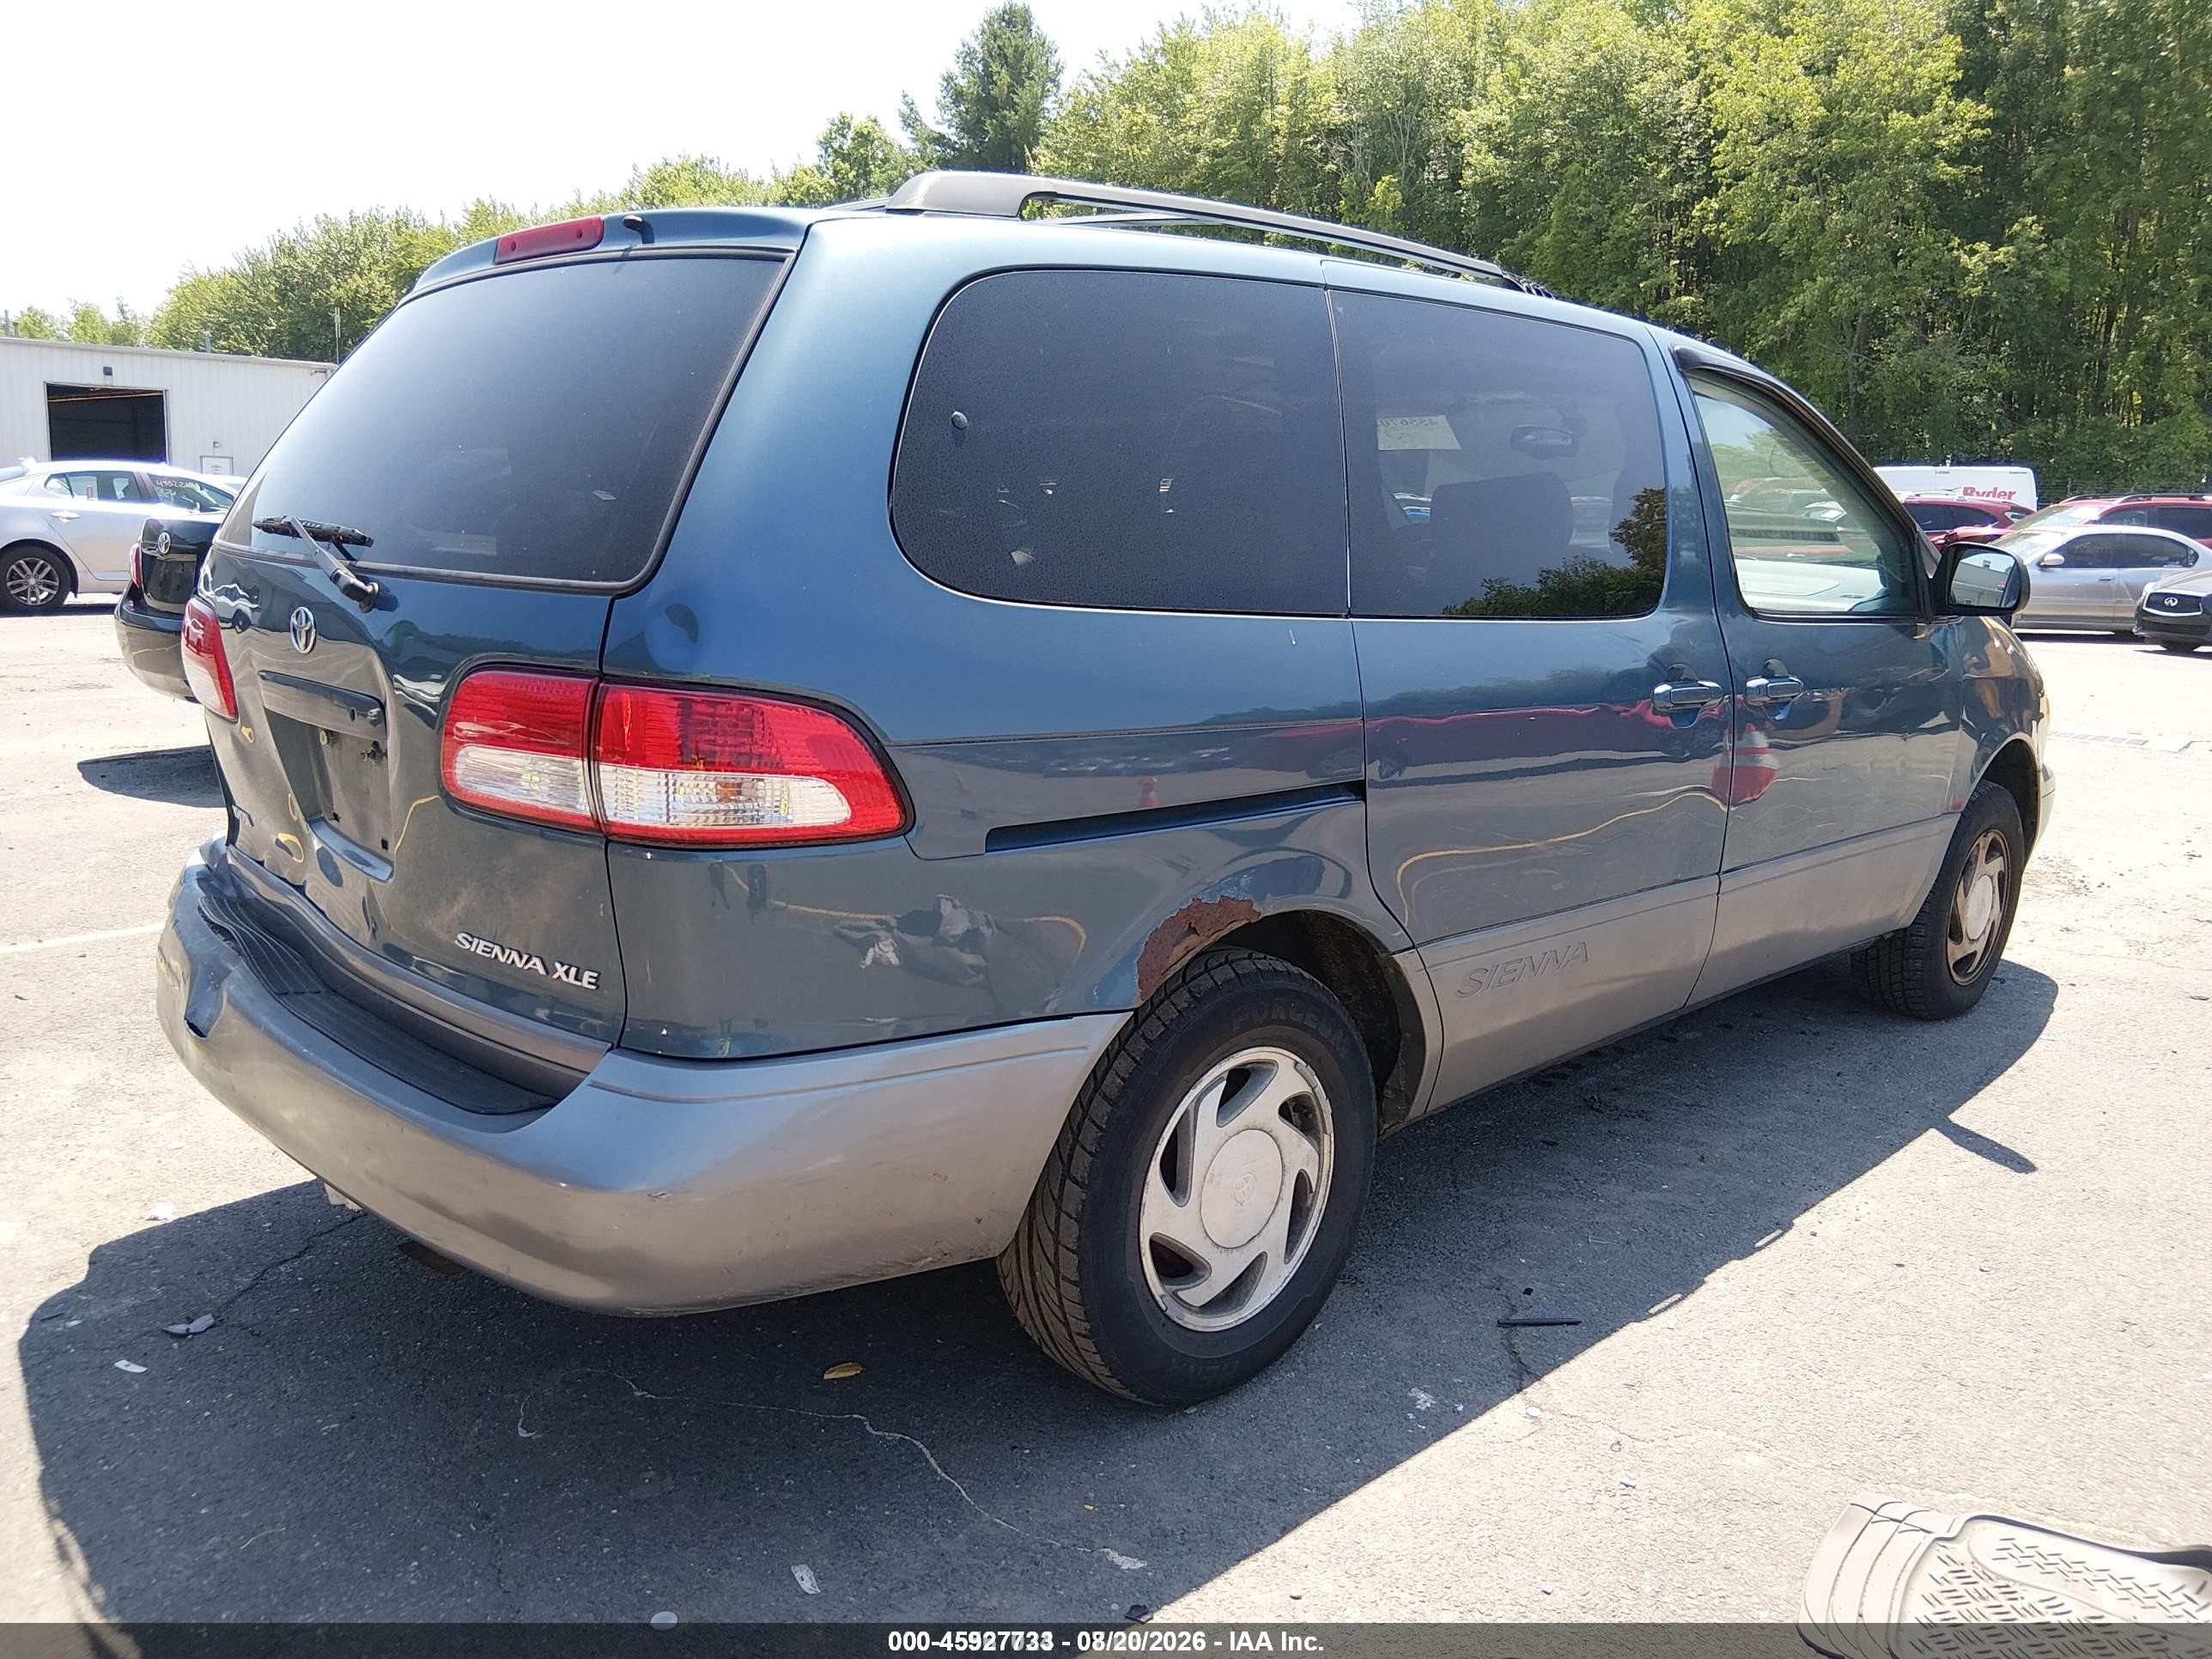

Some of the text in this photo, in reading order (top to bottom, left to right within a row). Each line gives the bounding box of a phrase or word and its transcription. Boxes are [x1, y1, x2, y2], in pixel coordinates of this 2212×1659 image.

[454, 932, 601, 990] SIENNA XLE
[1455, 941, 1589, 998] SIENNA
